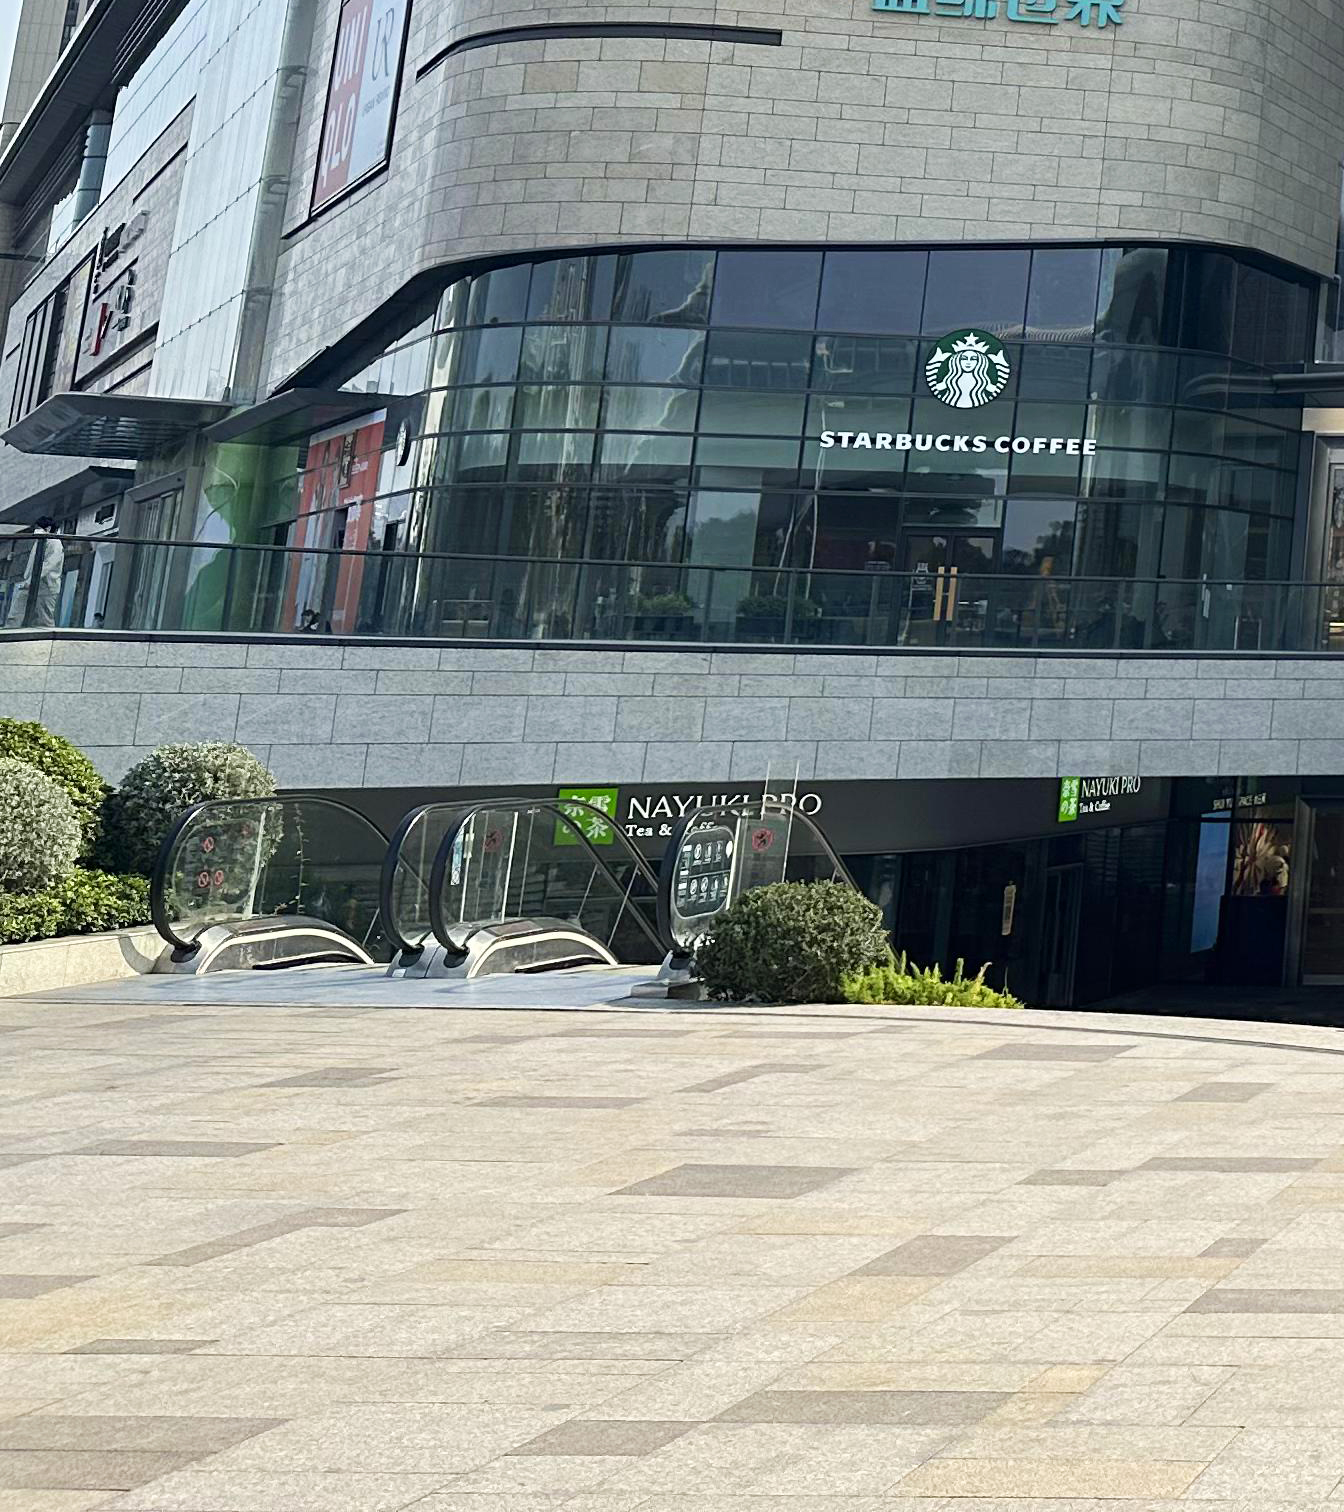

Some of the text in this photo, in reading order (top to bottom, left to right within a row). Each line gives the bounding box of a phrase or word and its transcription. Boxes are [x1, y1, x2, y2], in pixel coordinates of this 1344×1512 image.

[819, 430, 1097, 456] STARBUCKS COFFEE
[1081, 777, 1120, 798] NAYUKI
[627, 794, 755, 820] NAYUKI
[626, 824, 653, 837] Tea
[659, 824, 672, 837] &
